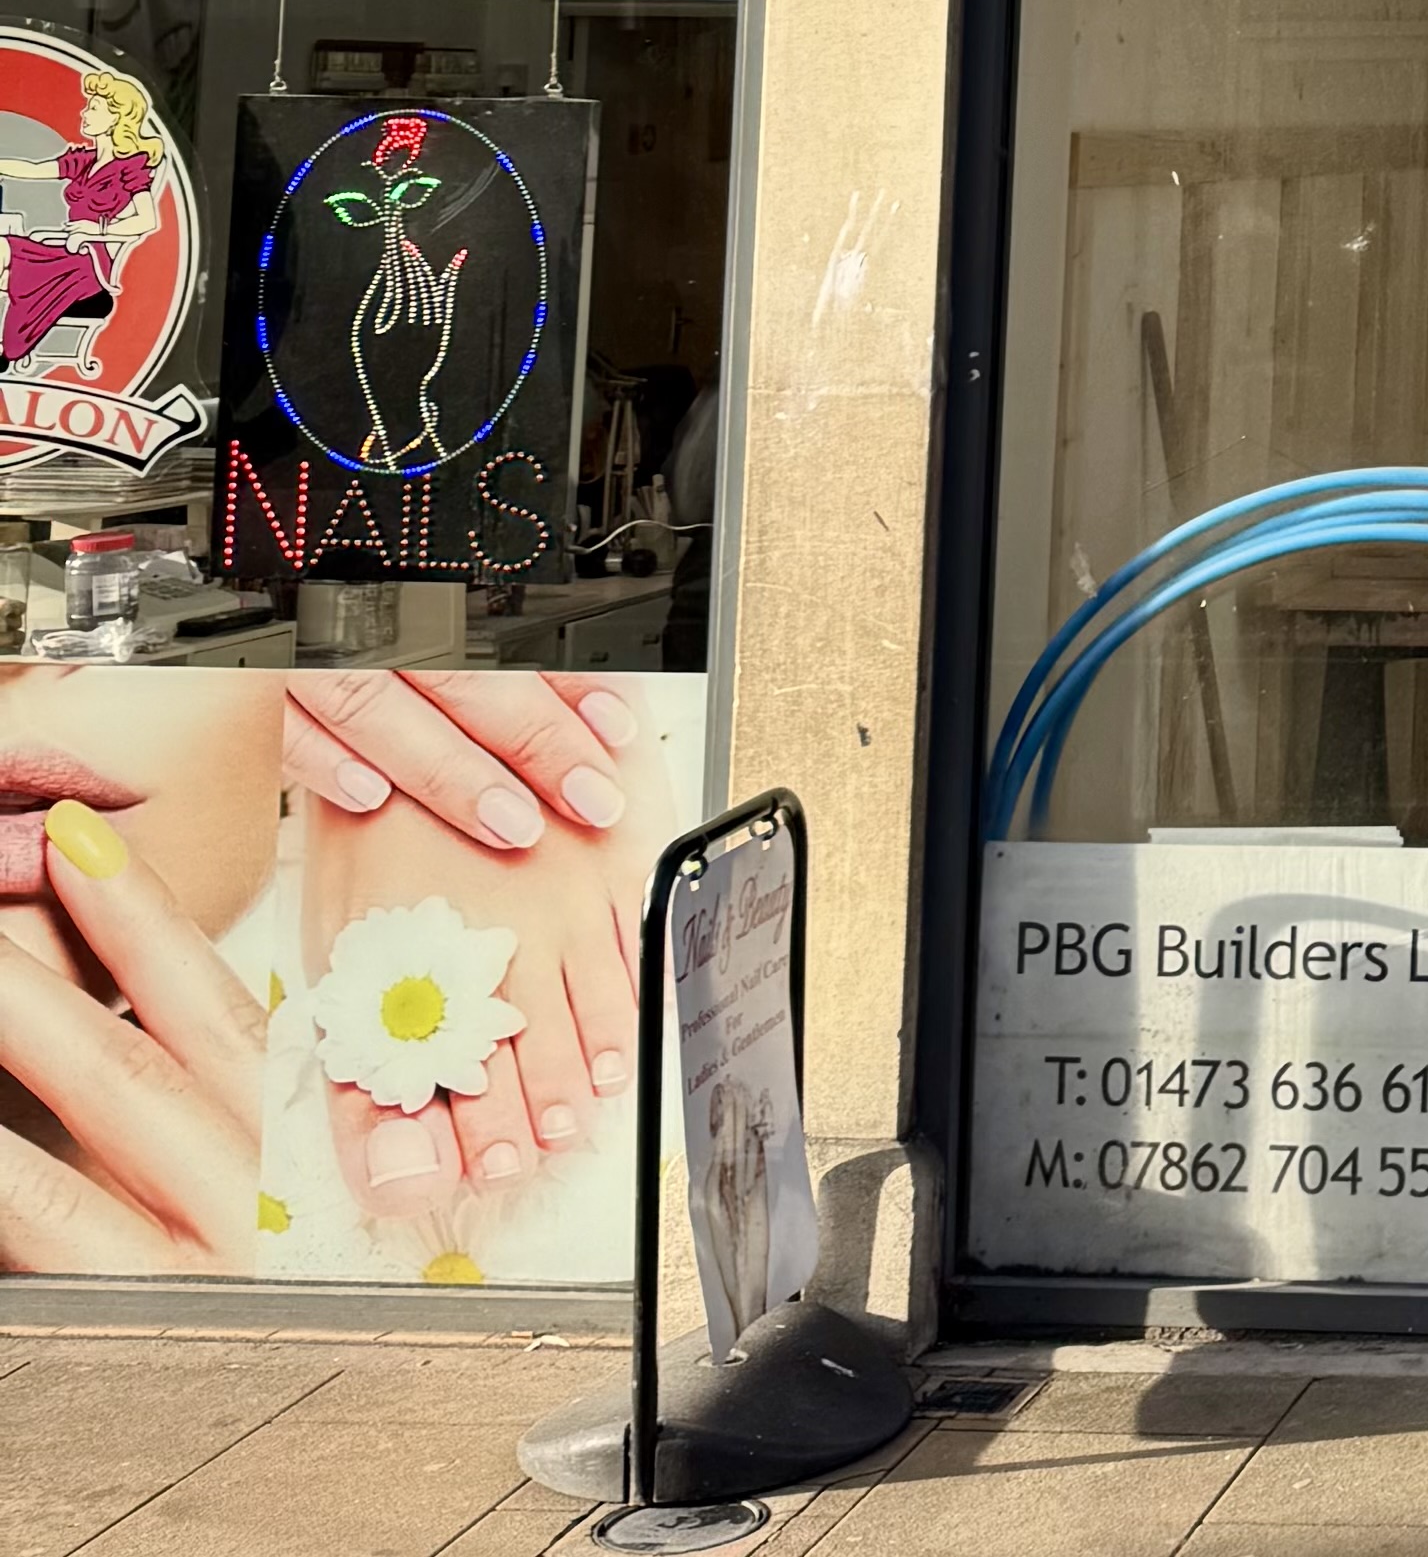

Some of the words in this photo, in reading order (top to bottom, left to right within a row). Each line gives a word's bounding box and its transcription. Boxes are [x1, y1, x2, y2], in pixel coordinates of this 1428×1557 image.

[224, 439, 549, 573] NAILS
[1016, 921, 1133, 977] PBG
[1157, 925, 1389, 982] Builders
[1100, 1056, 1251, 1111] 01473
[1271, 1062, 1363, 1113] 636
[1097, 1140, 1249, 1193] 07862
[1269, 1144, 1362, 1195] 704
